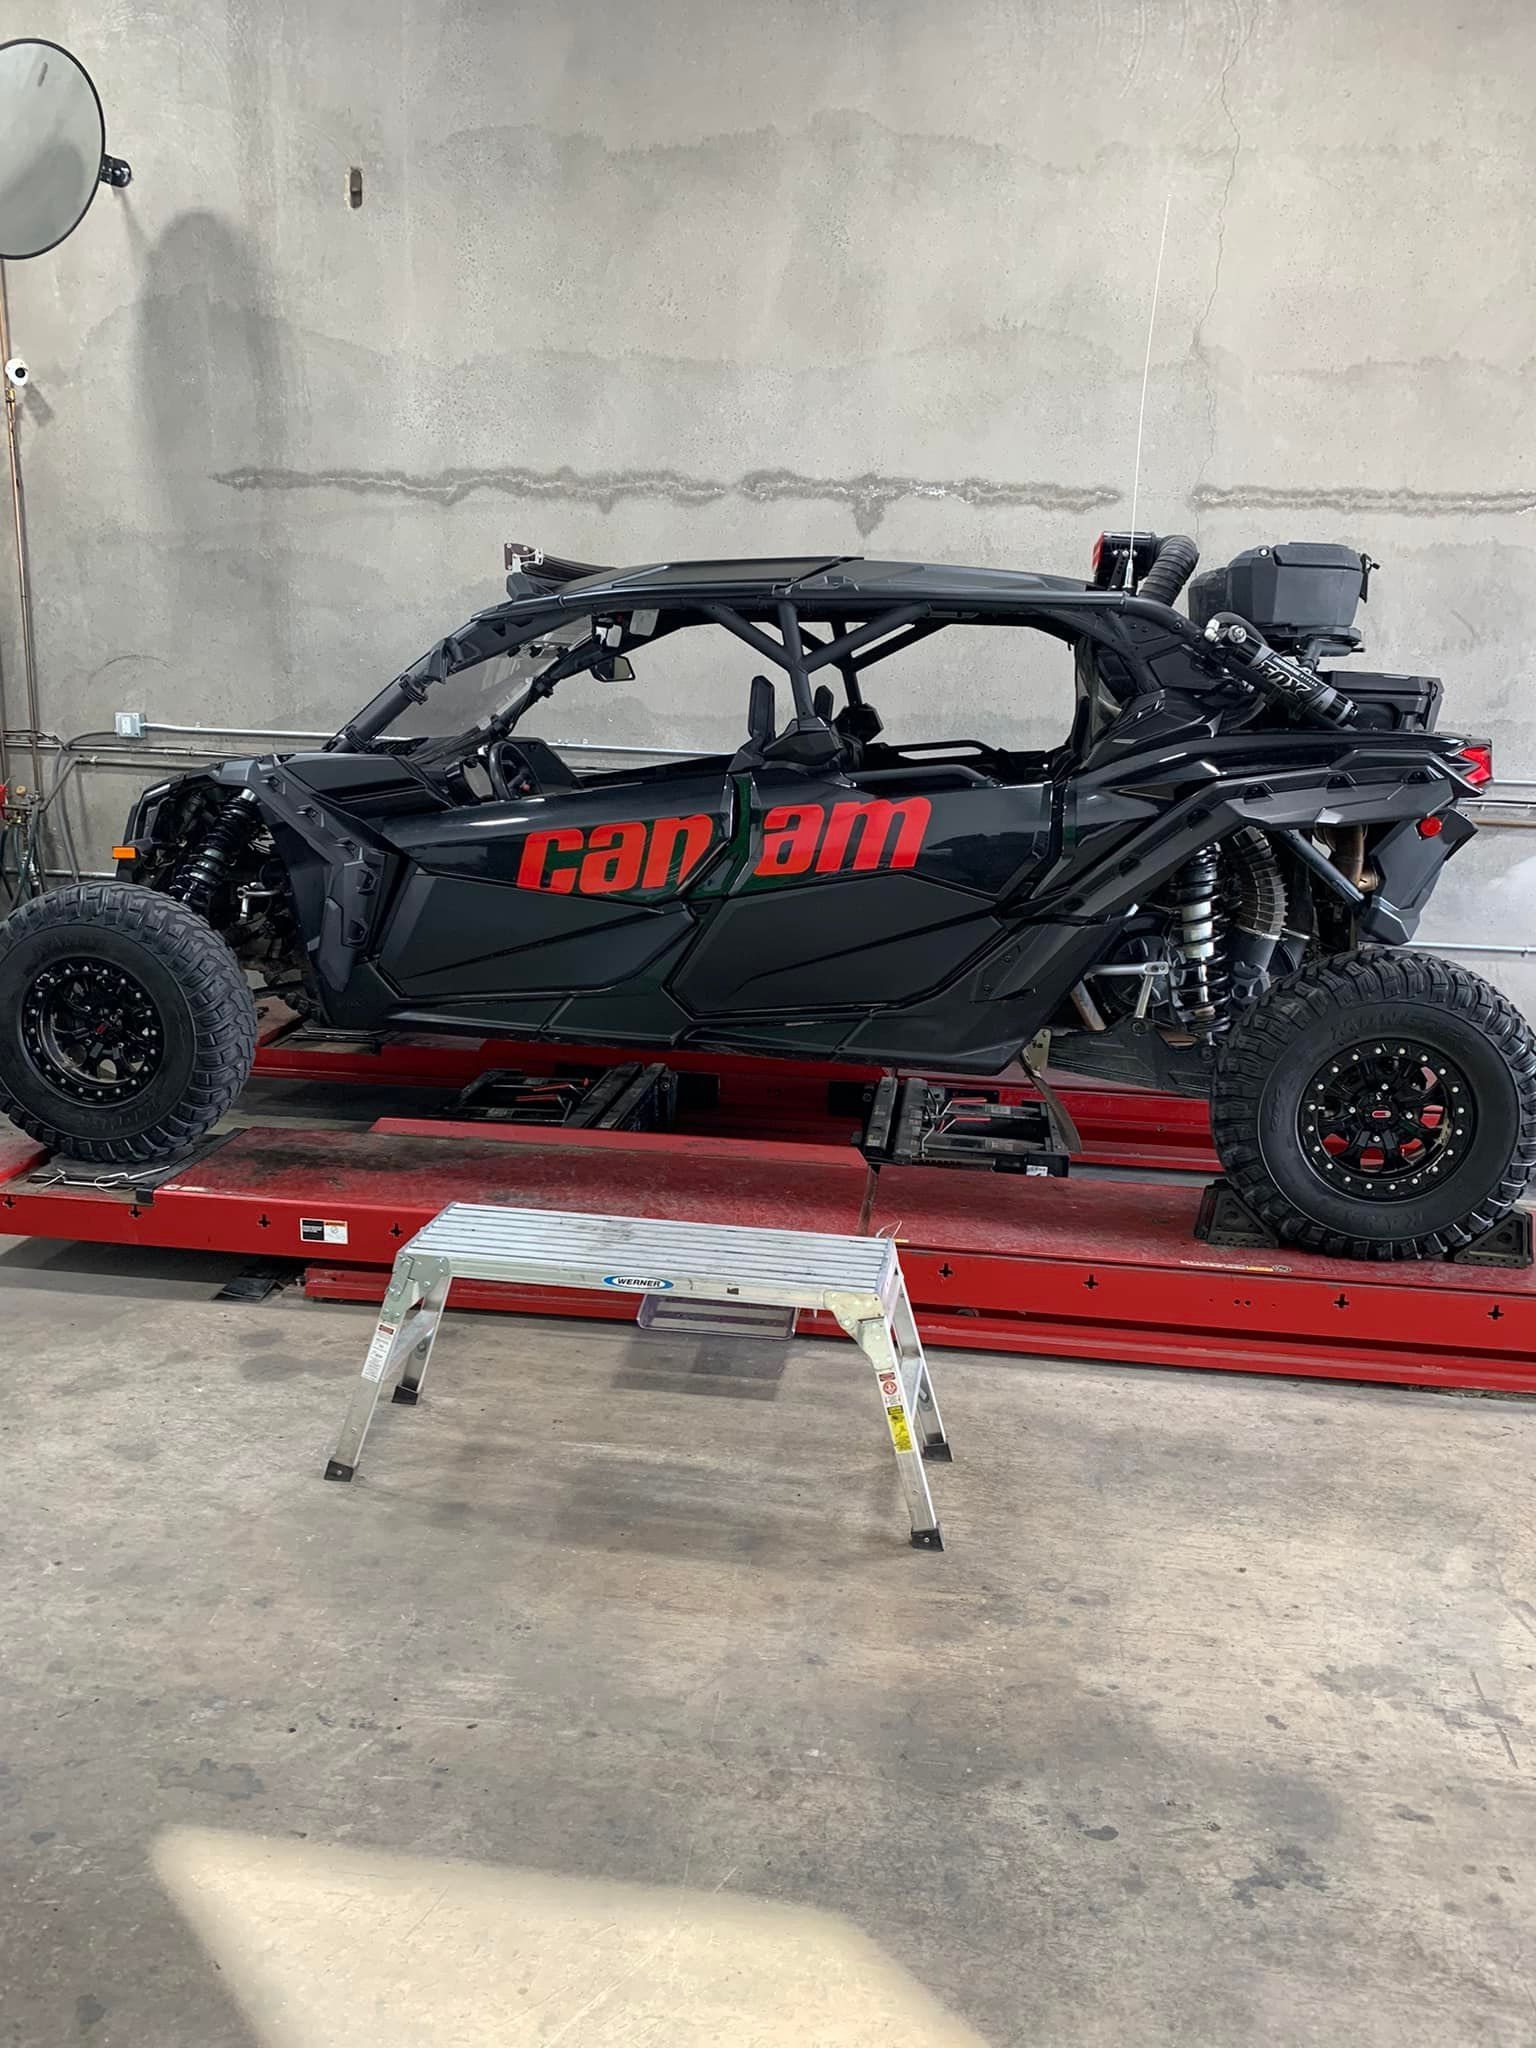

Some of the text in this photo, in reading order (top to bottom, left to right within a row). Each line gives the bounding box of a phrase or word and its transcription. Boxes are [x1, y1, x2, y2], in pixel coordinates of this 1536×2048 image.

[1256, 660, 1312, 695] FOX
[516, 796, 932, 895] can am
[618, 1278, 660, 1287] WERNER
